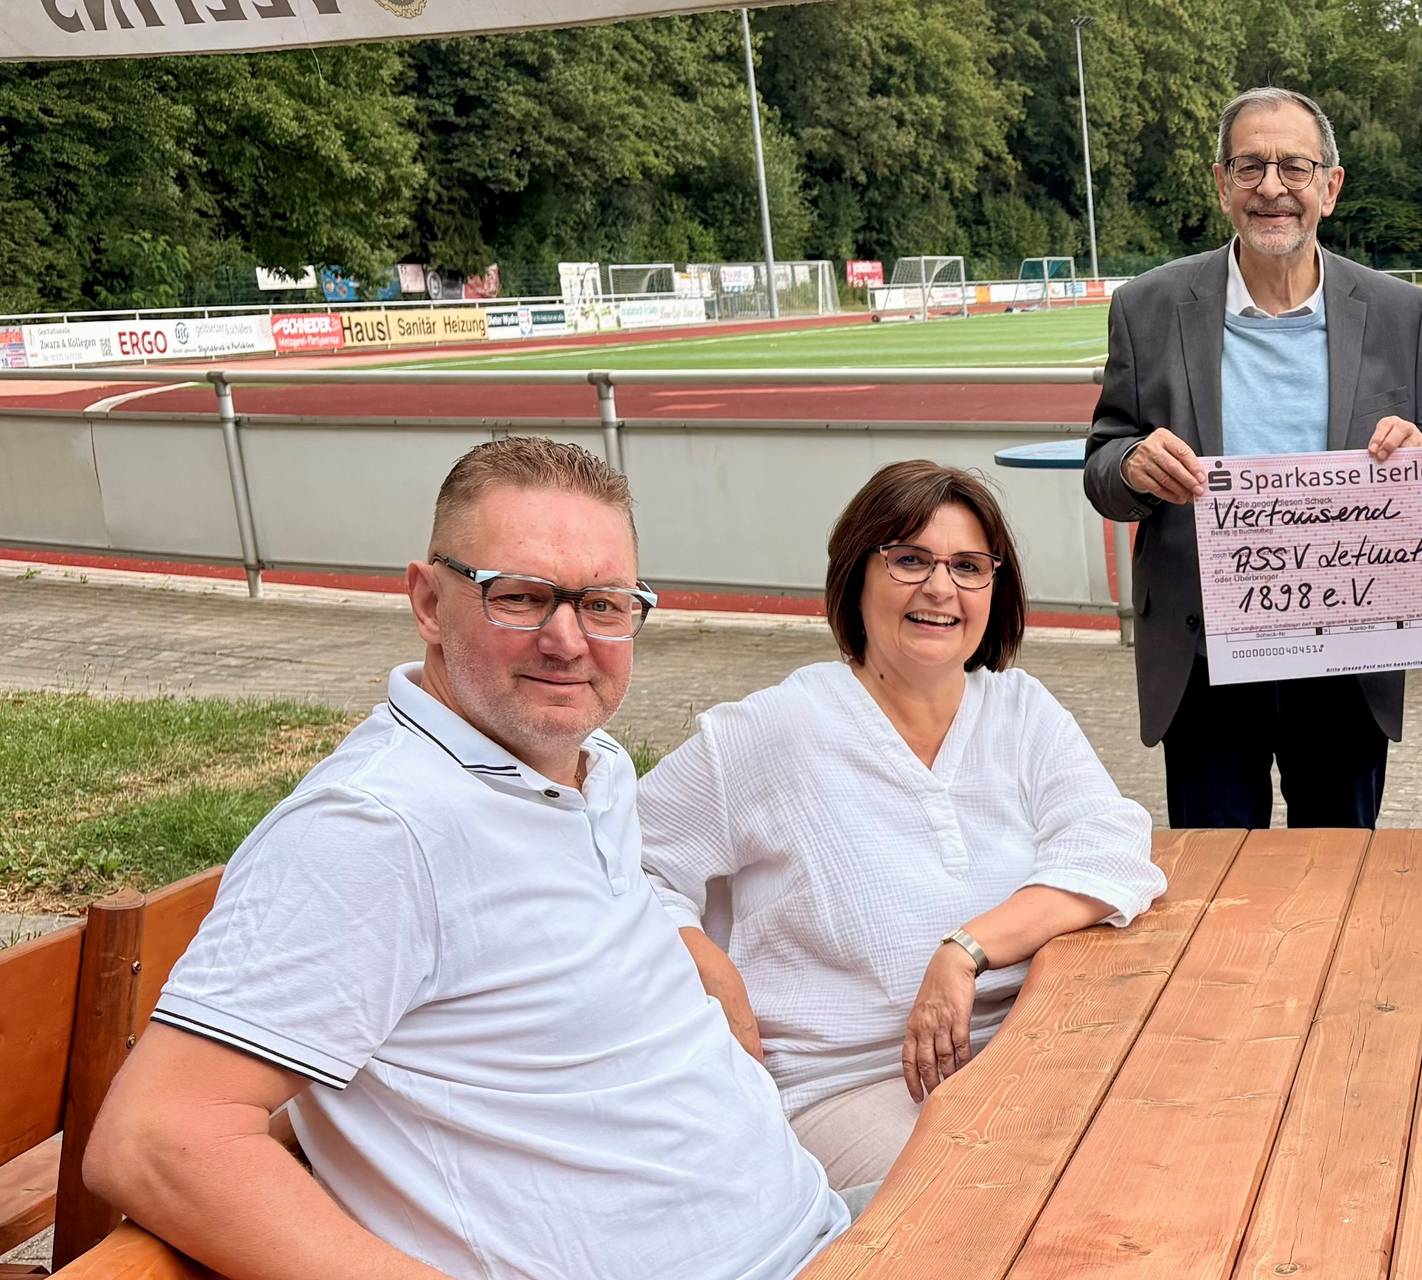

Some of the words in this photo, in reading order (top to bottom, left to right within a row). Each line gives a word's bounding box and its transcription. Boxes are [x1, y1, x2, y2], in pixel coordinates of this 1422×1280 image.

[398, 317, 437, 337] Sanitär
[443, 314, 486, 337] Heizung
[118, 330, 168, 355] ERGO
[1240, 466, 1361, 495] Sparkasse
[1213, 497, 1401, 529] Viertausend
[1238, 582, 1312, 613] 1898
